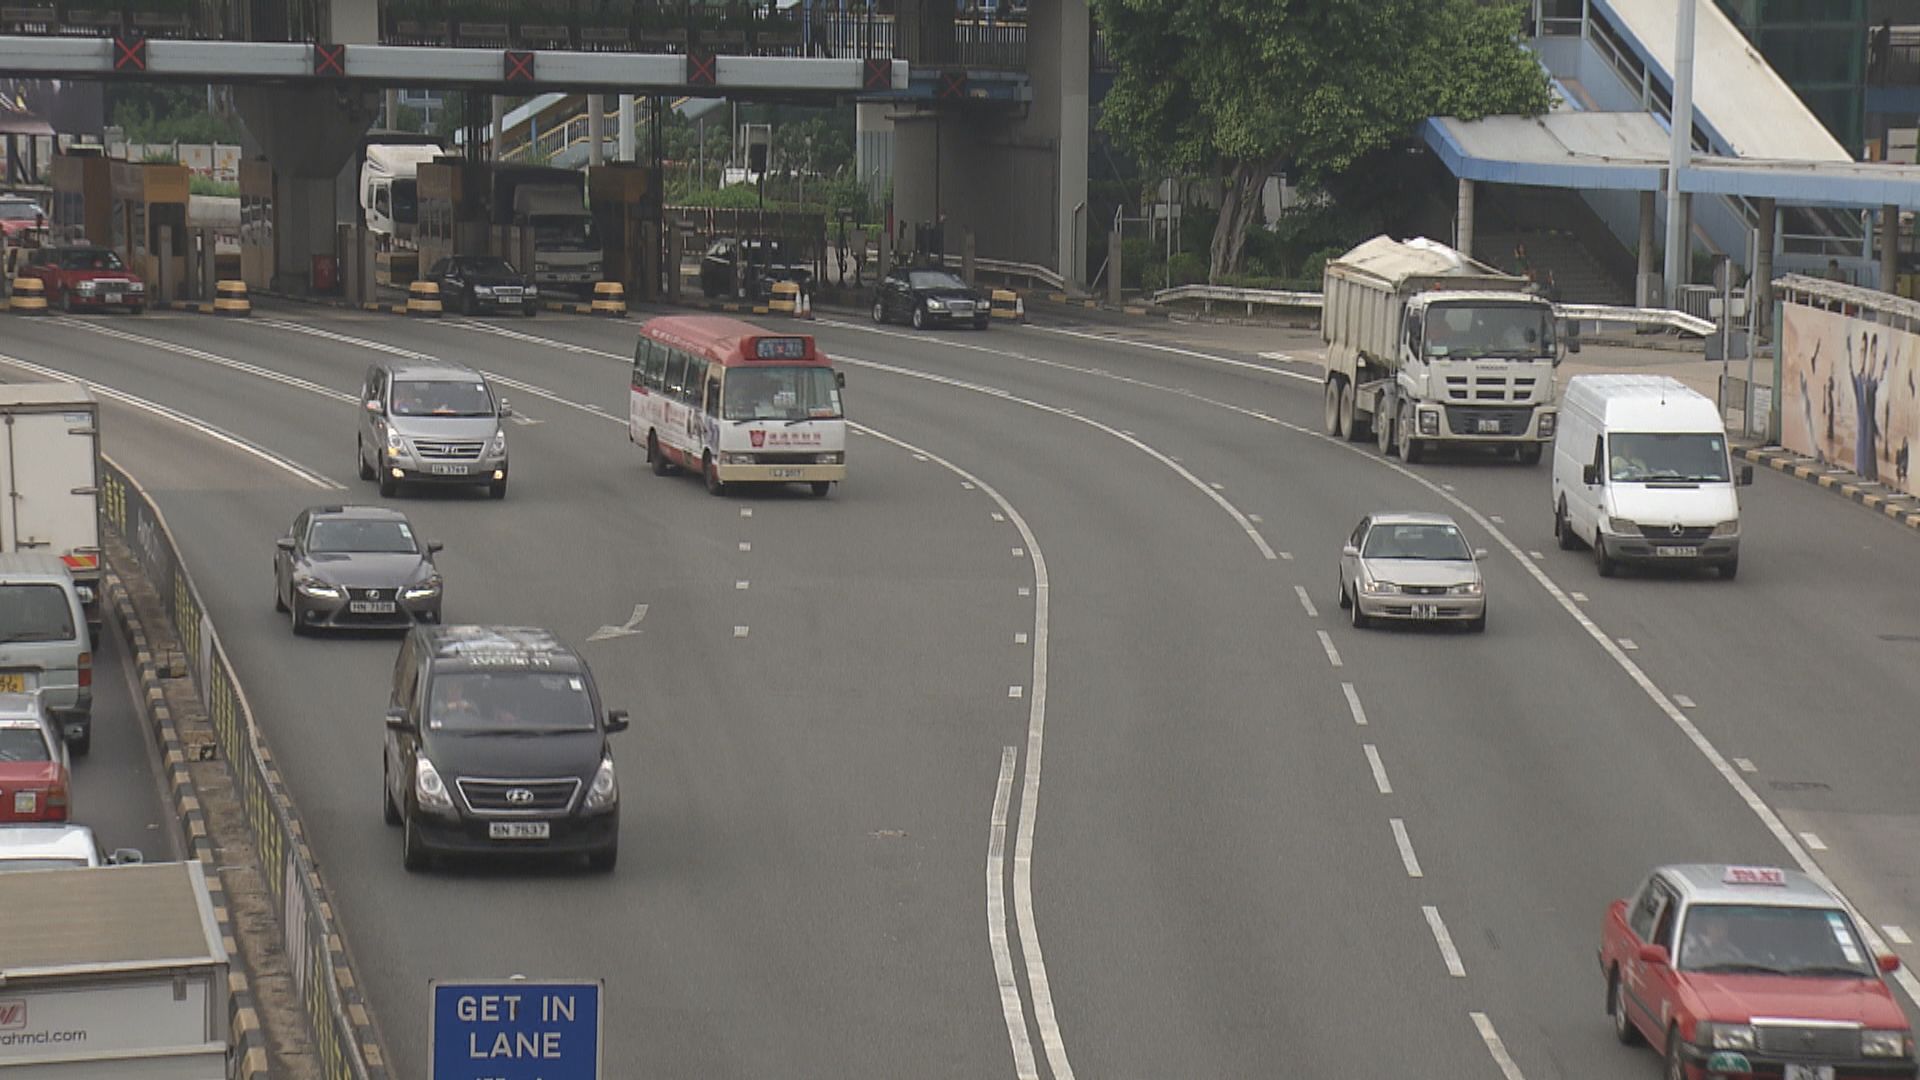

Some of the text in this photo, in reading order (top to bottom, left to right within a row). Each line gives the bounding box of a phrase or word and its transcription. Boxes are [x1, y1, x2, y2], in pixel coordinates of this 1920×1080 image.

[1732, 868, 1782, 882] TAXI
[457, 995, 575, 1022] GET IN
[469, 1031, 561, 1059] LANE
